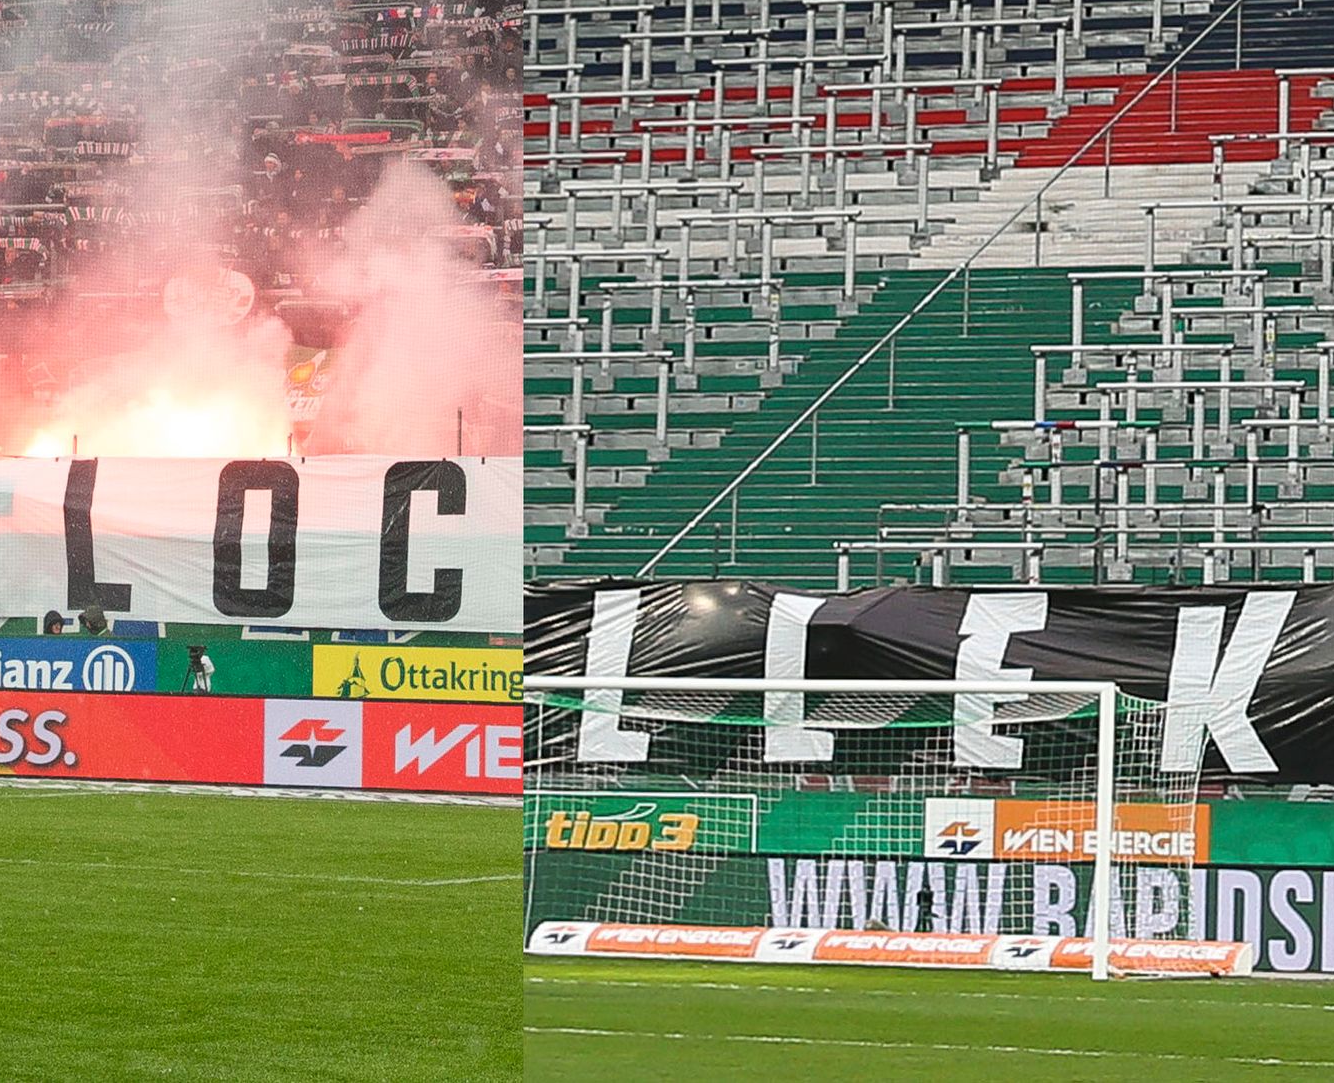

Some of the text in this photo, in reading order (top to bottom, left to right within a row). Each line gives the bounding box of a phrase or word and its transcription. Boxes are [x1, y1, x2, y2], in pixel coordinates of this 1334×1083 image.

[395, 723, 522, 779] WIE
[1003, 829, 1075, 854] WIEN
[597, 928, 760, 946] WIEN ENERGIE
[825, 934, 990, 954] WIEN ENERGIE
[1128, 943, 1235, 961] ENERGIE
